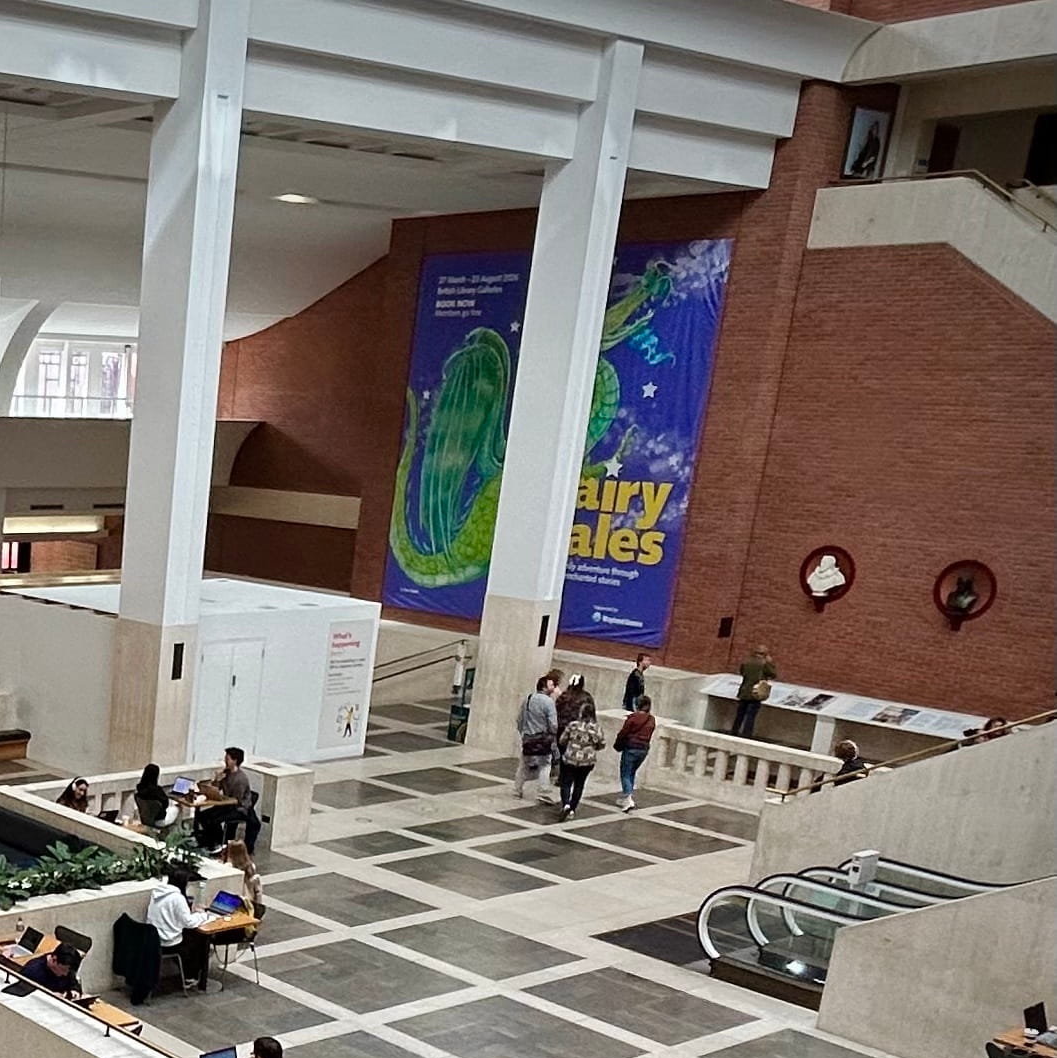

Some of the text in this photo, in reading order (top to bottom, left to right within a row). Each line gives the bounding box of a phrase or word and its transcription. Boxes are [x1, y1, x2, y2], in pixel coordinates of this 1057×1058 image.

[436, 299, 475, 308] BOOK NOW
[576, 477, 673, 529] airy
[568, 512, 666, 565] ales
